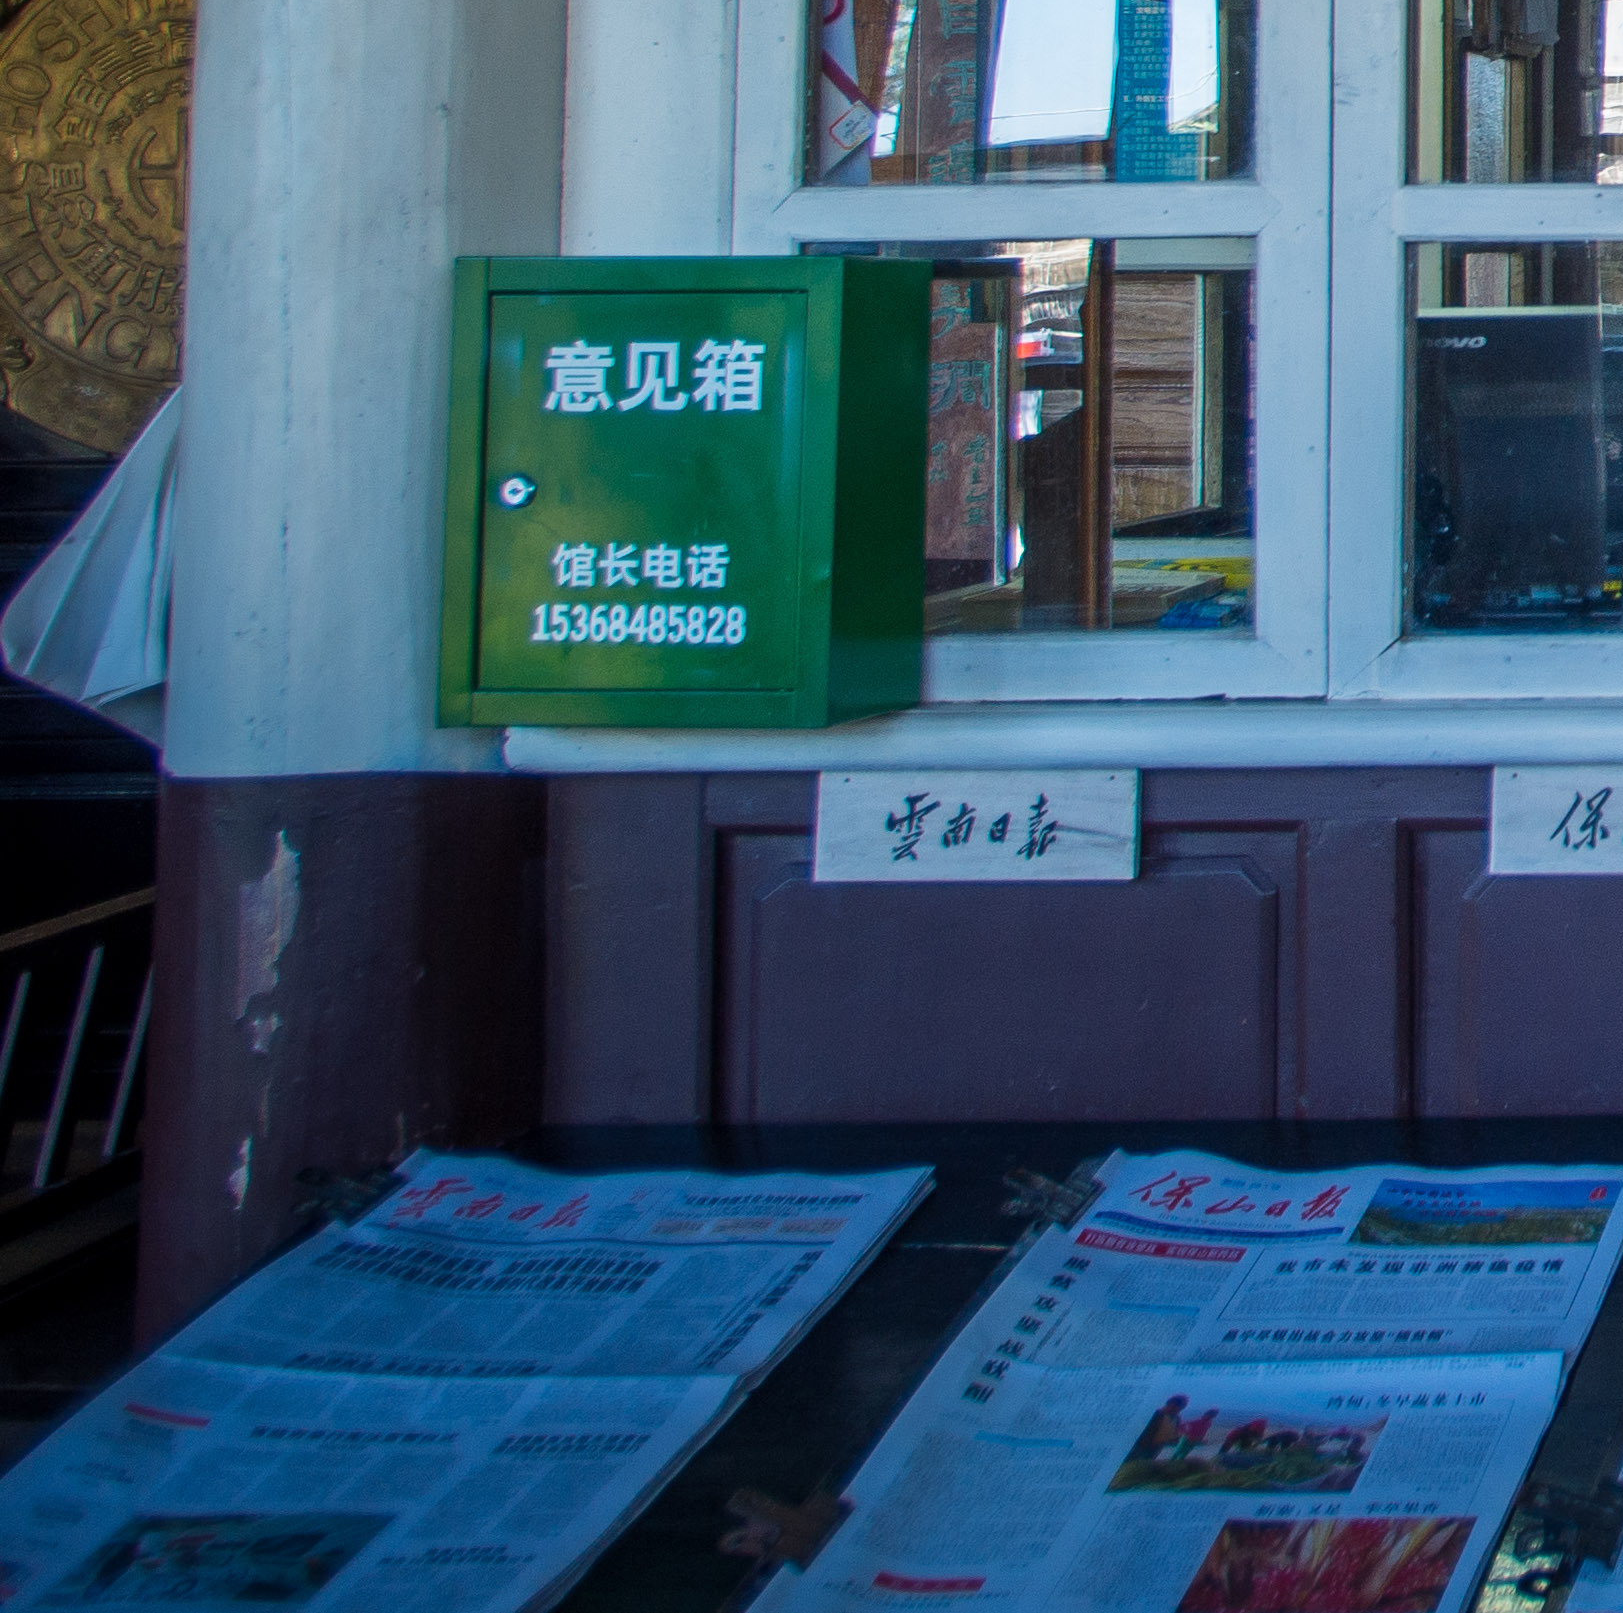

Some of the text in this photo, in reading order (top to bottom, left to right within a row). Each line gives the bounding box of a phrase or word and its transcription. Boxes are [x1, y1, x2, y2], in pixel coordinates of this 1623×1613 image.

[544, 339, 766, 412] 意见箱
[552, 543, 730, 589] 馆长电话
[531, 603, 746, 645] 15368485828
[1277, 1257, 1564, 1276] 我市未发现非洲猪瘟疫情
